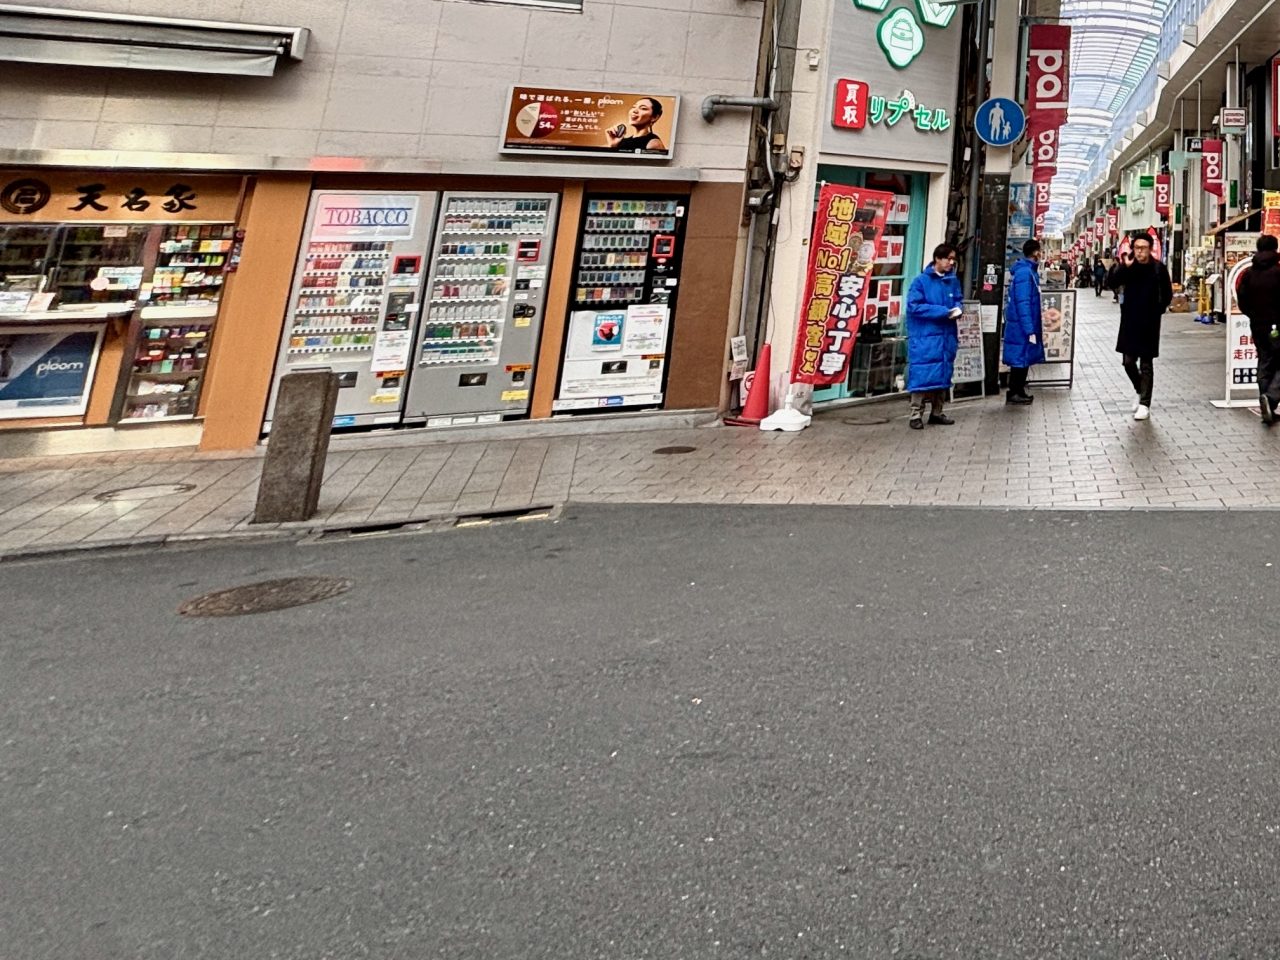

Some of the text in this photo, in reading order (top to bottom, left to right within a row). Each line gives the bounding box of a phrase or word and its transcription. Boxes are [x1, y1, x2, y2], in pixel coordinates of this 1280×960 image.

[1029, 49, 1069, 109] pal
[598, 95, 624, 109] ploom
[842, 84, 859, 125] 買取
[870, 93, 951, 131] リプセル
[1203, 152, 1222, 184] pal
[1036, 183, 1050, 207] pal
[1156, 184, 1171, 208] pal
[326, 208, 409, 225] TOBACCO
[1109, 215, 1117, 231] pal
[1233, 349, 1259, 360] 走行
[36, 357, 84, 379] ploom
